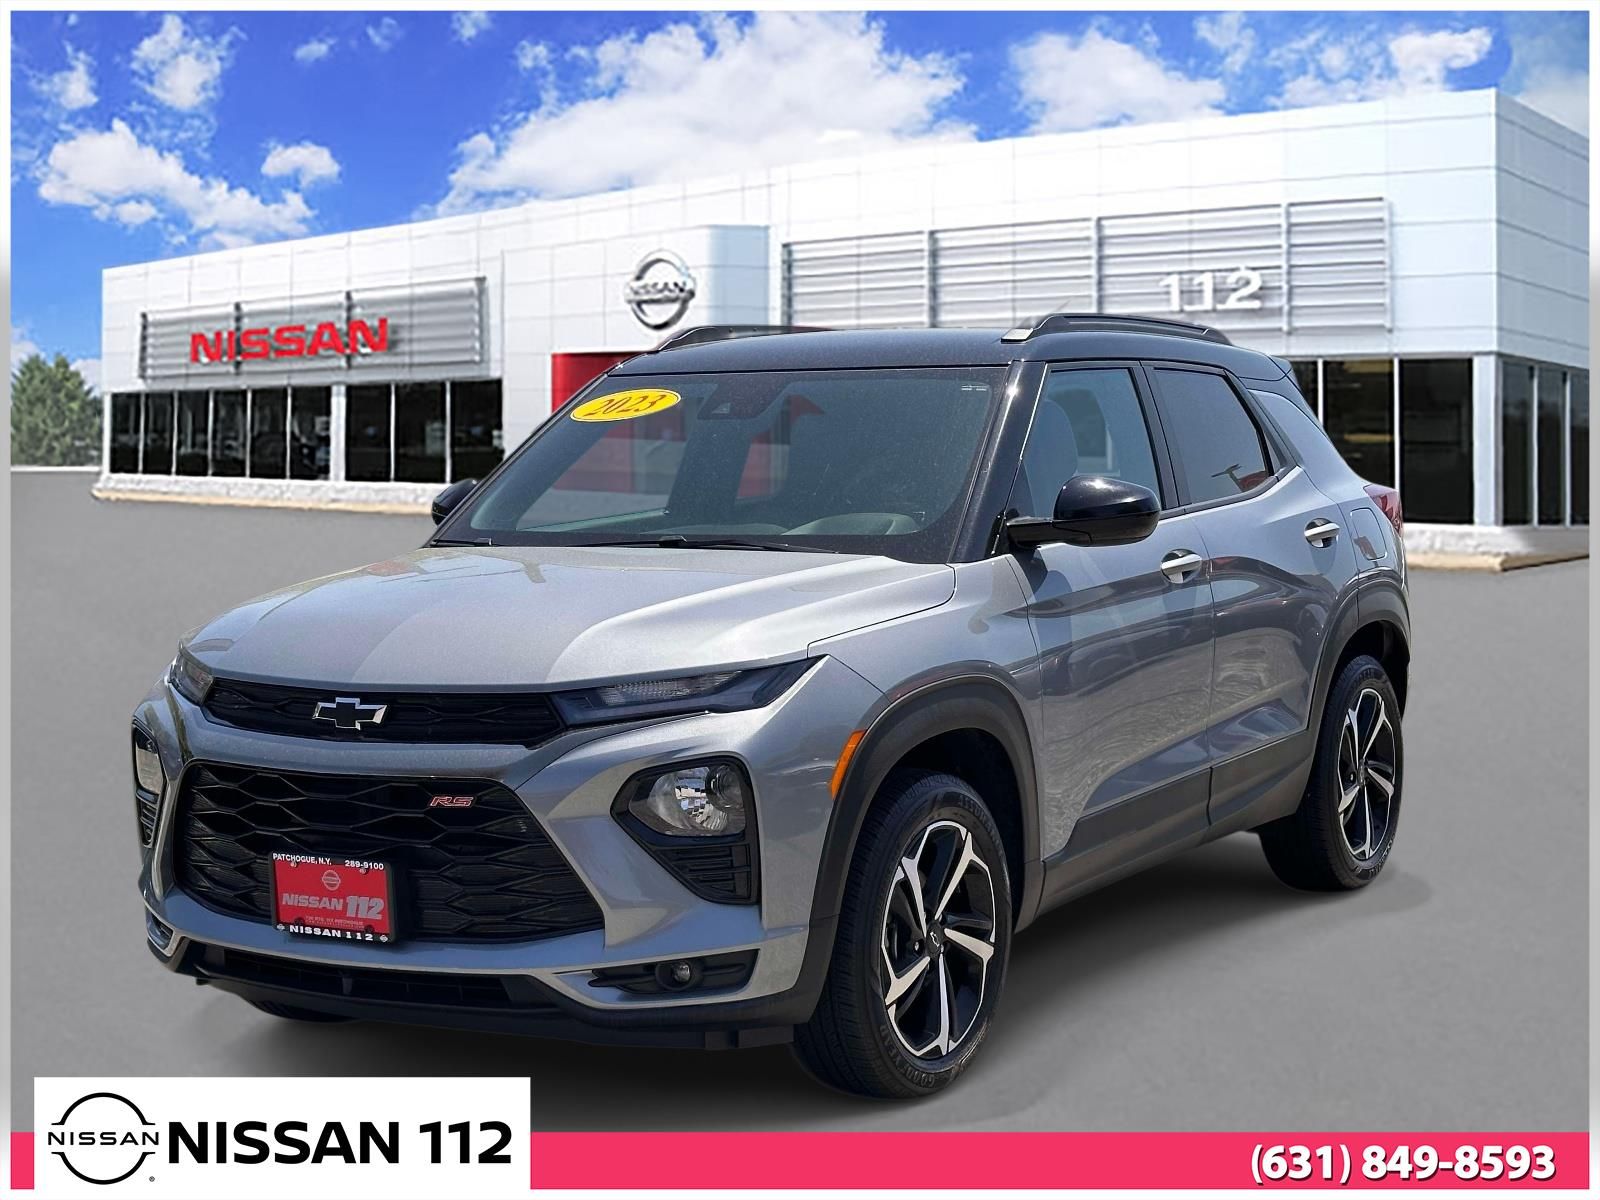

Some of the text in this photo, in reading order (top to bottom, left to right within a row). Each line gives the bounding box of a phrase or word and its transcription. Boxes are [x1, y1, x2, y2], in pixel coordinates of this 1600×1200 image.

[628, 282, 690, 296] NISSAN
[1159, 268, 1262, 311] 112
[190, 317, 388, 363] NISSAN
[583, 394, 667, 417] 2023
[430, 796, 474, 807] RS
[273, 853, 384, 870] PATCHOGUE, N.Y. 289-9100
[282, 893, 343, 911] NISSAN
[346, 895, 385, 920] 112
[289, 924, 341, 938] NISSAN
